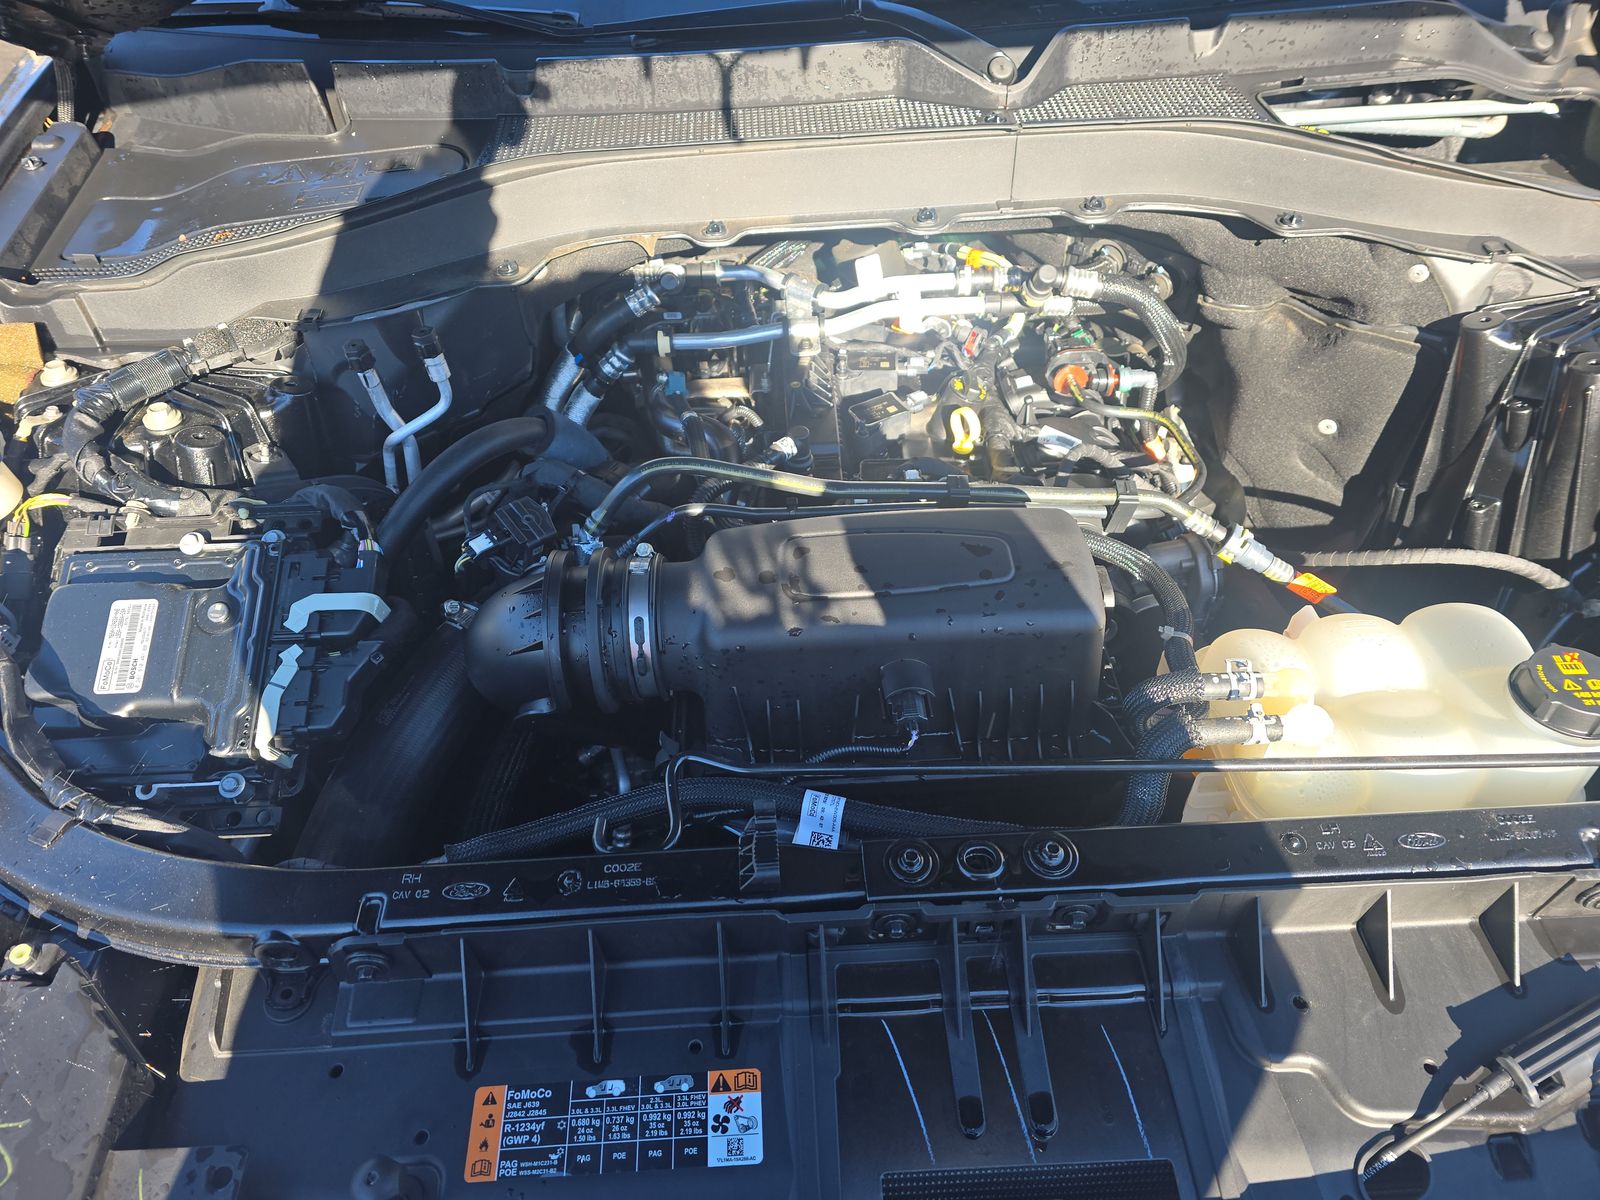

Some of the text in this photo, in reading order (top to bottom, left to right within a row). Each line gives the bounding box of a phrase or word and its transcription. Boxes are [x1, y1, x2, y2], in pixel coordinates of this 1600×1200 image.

[129, 658, 138, 680] BOSCH
[100, 661, 113, 690] FoMoCo
[402, 873, 422, 884] RH
[392, 889, 431, 900] CAV 02
[507, 1088, 552, 1100] FoMoCo
[523, 1101, 540, 1109] J639
[527, 1109, 547, 1117] J2845
[643, 1113, 672, 1122] 0.992 kg
[677, 1111, 706, 1120] 0.992 kg
[571, 1118, 600, 1127] 0.680 kg
[606, 1116, 634, 1125] 0.737 kg
[504, 1121, 545, 1133] R-1234yf
[502, 1134, 541, 1147] (GWP 4)
[648, 1150, 663, 1158] PAG
[684, 1147, 698, 1155] POE
[613, 1152, 627, 1160] POE
[500, 1160, 518, 1168] PAG
[499, 1169, 517, 1177] POE
